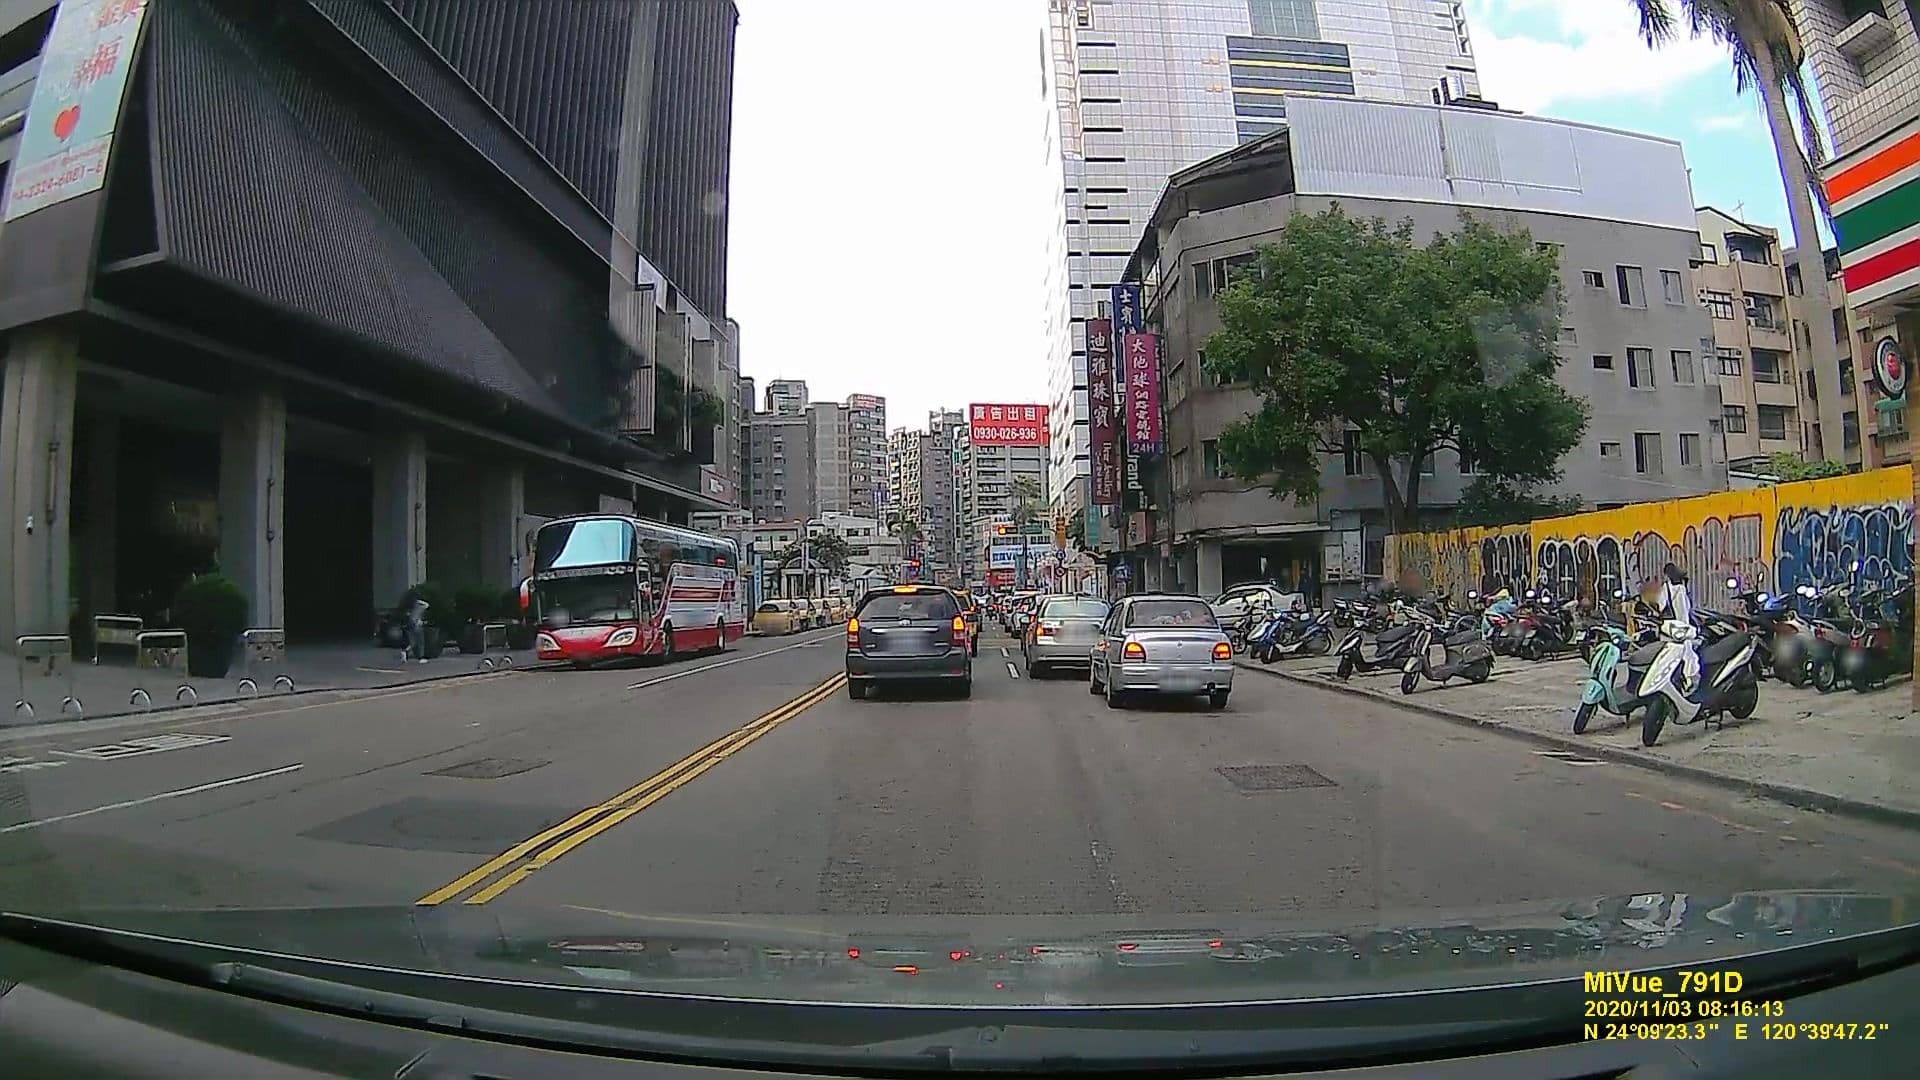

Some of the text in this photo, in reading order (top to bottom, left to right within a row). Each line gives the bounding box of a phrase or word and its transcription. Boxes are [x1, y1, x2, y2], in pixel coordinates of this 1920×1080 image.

[1090, 331, 1110, 428] 迪雅珠寶
[973, 406, 1036, 420] 廣告出租
[973, 426, 1037, 440] 0930-026-936
[1133, 443, 1155, 453] 24H
